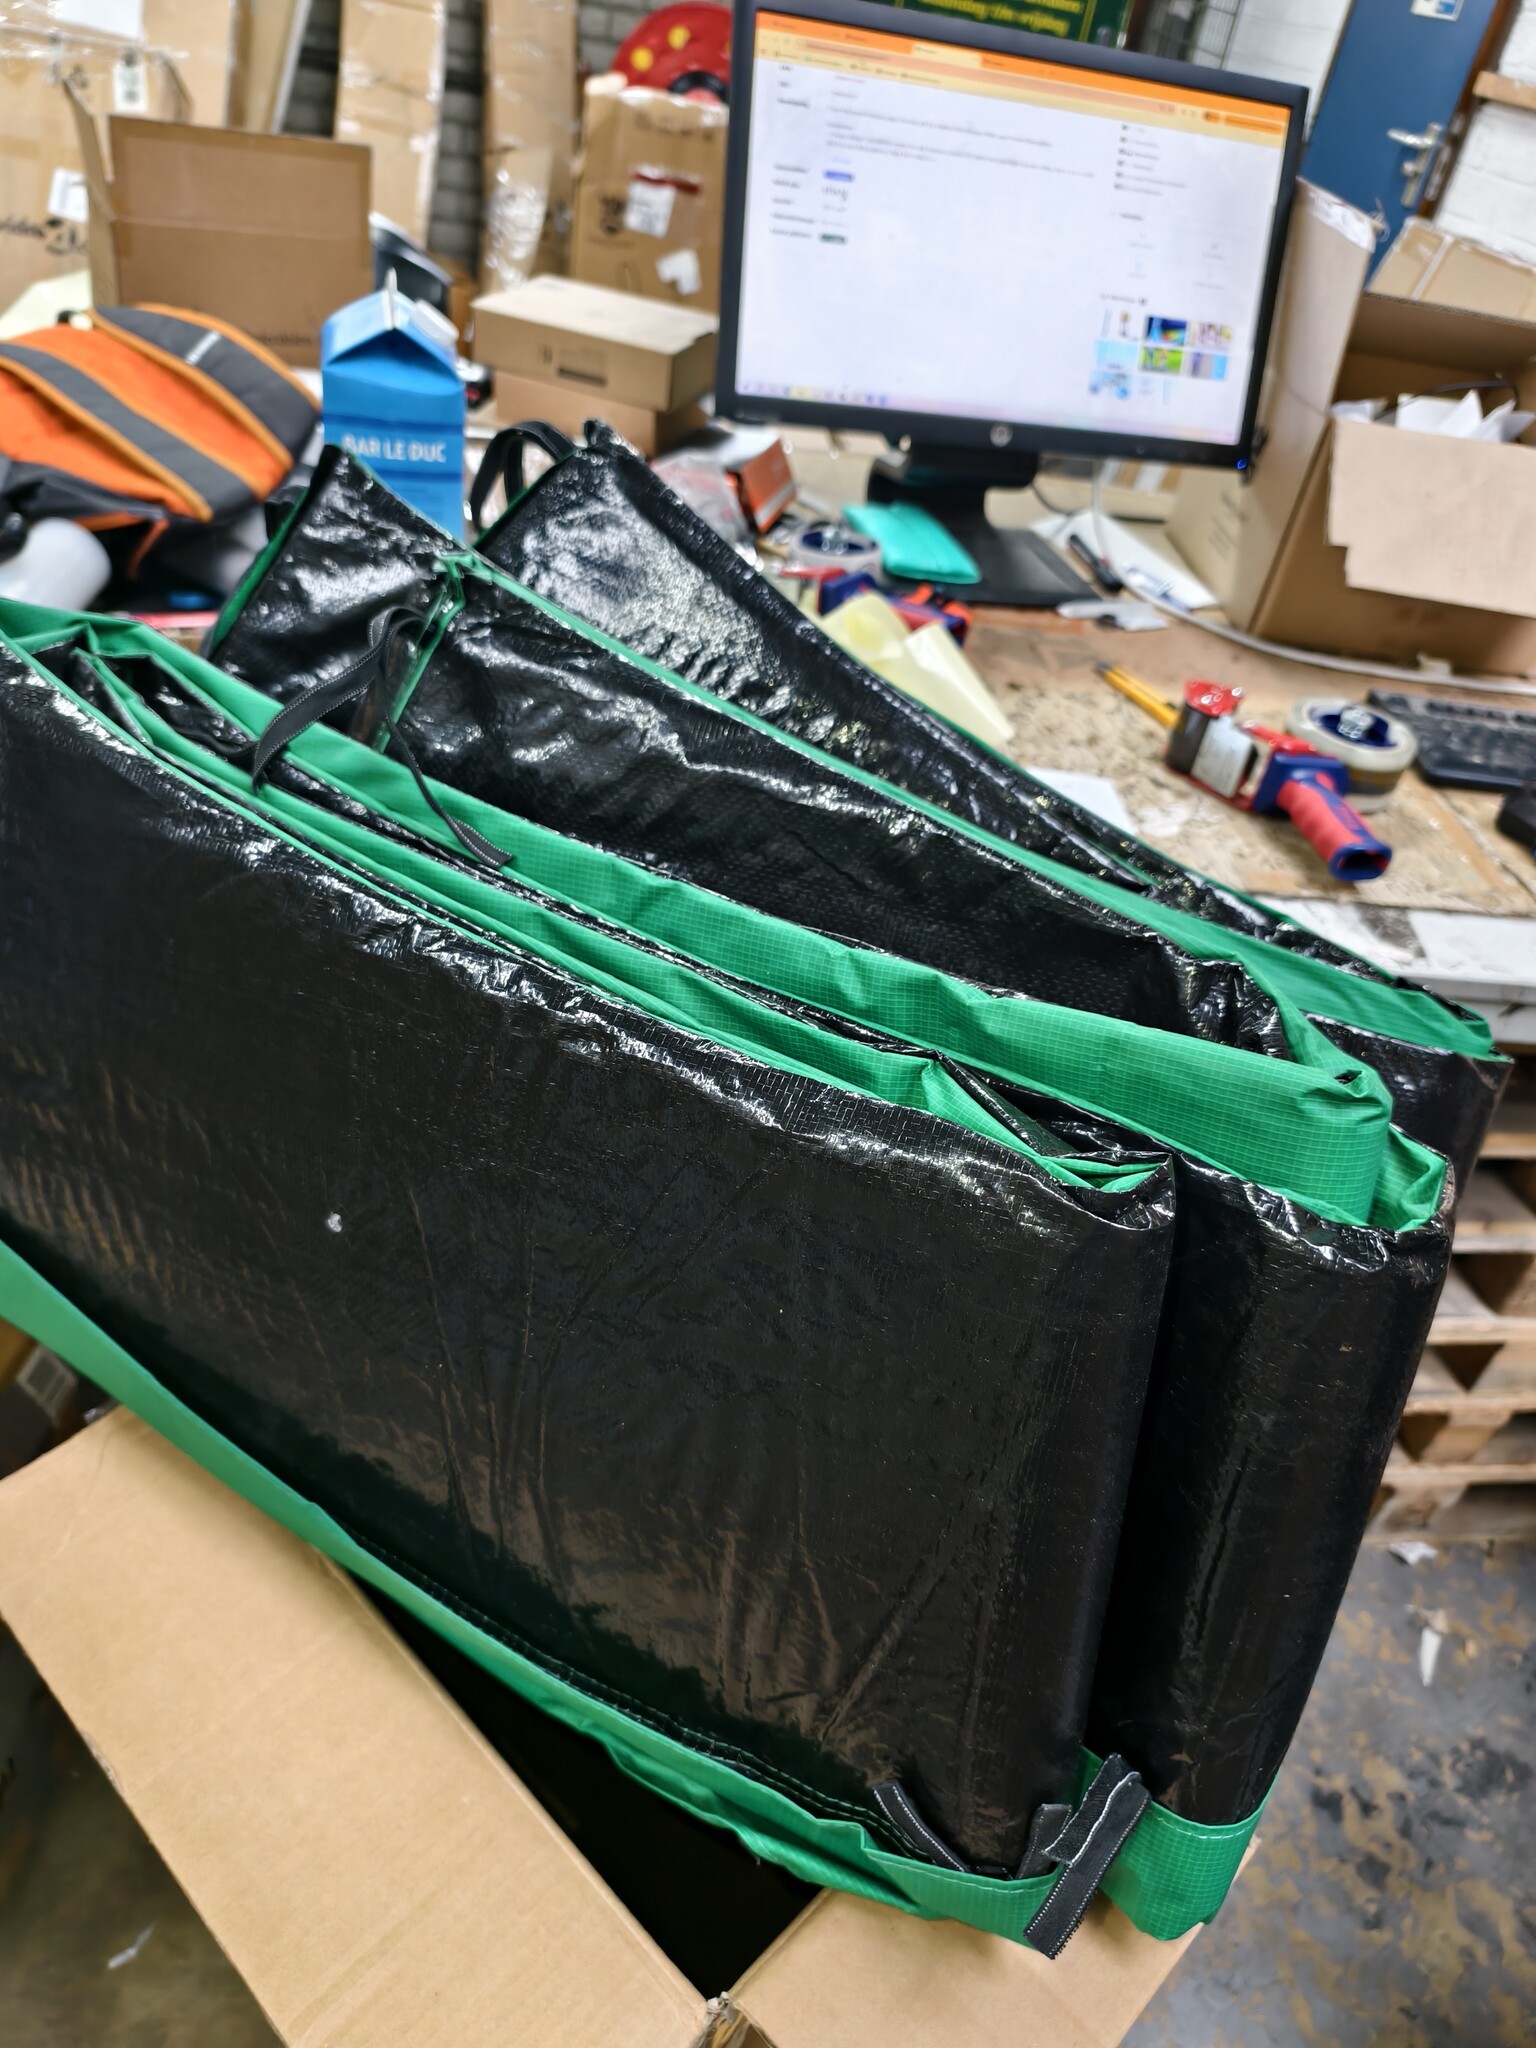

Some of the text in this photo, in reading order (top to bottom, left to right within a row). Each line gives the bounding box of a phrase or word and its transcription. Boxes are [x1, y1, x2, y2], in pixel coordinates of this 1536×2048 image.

[342, 433, 446, 463] BAR LE DUC
